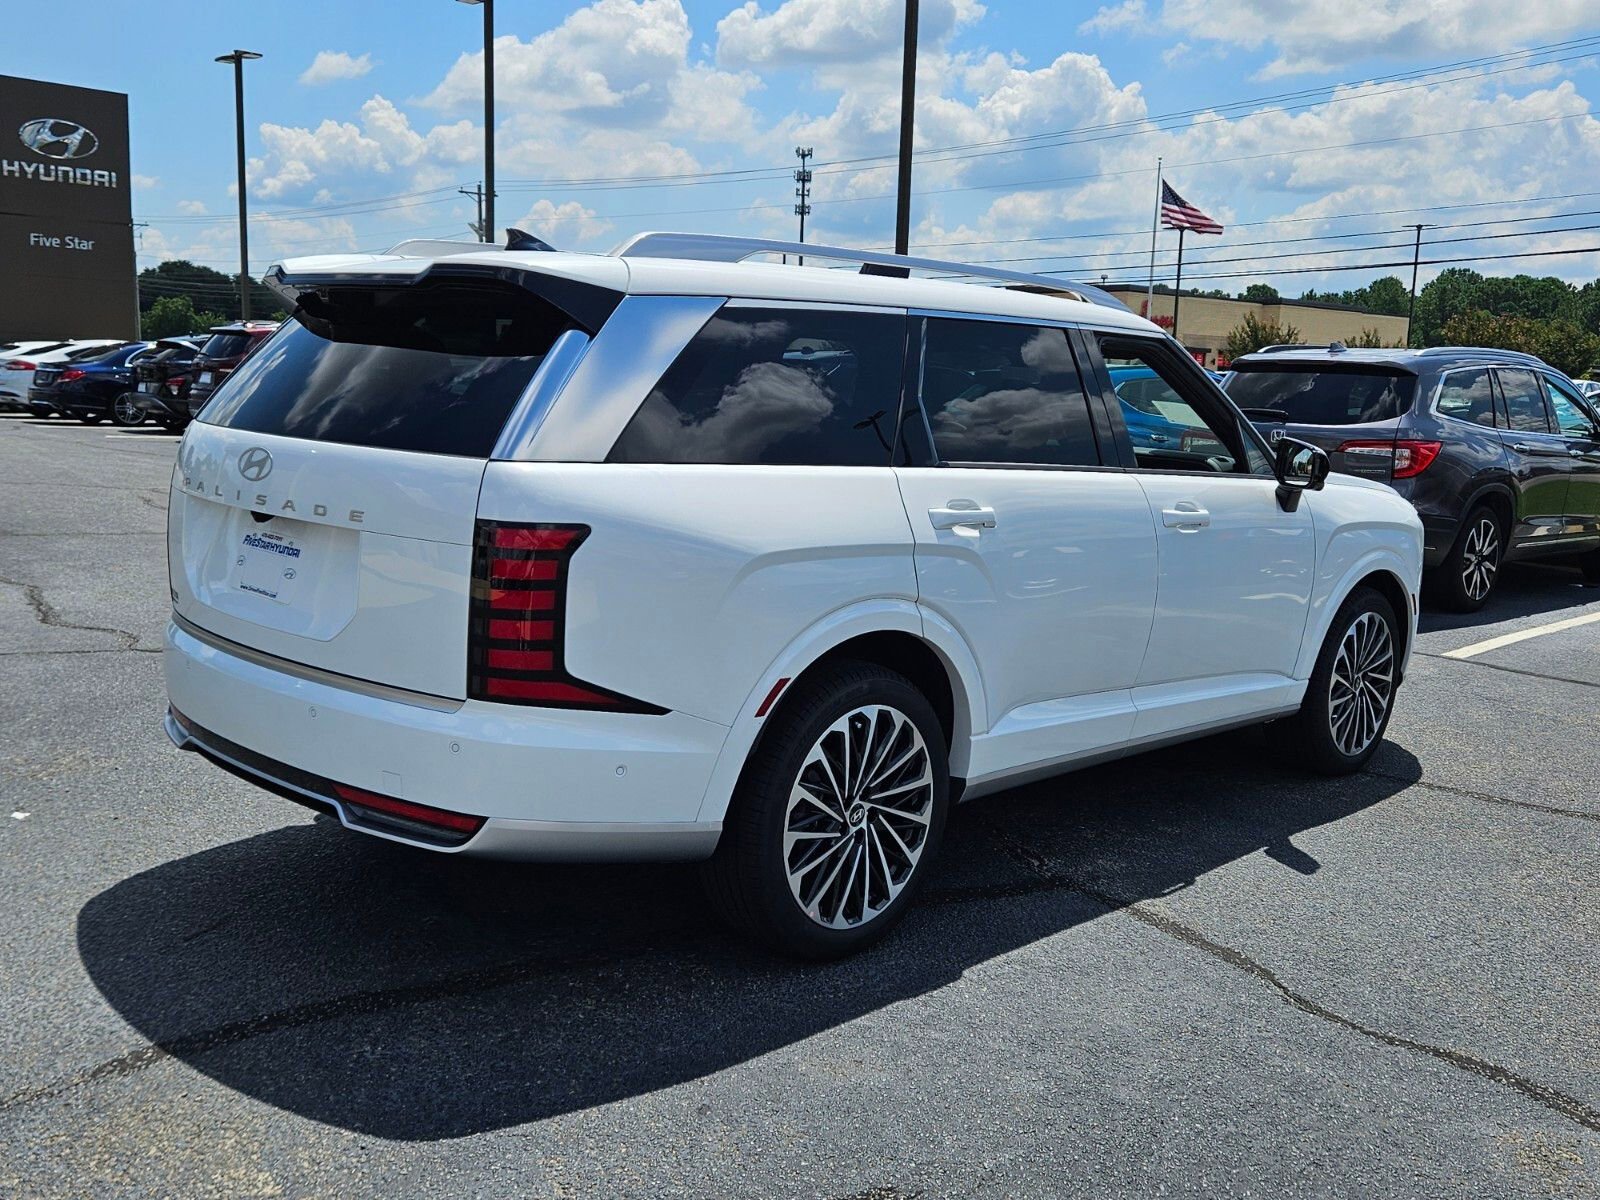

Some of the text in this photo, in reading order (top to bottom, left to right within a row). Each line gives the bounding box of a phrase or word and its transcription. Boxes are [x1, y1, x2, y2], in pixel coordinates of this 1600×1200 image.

[2, 159, 117, 188] HYUNDAI
[30, 232, 96, 250] Five Star
[183, 477, 365, 523] PALISADE
